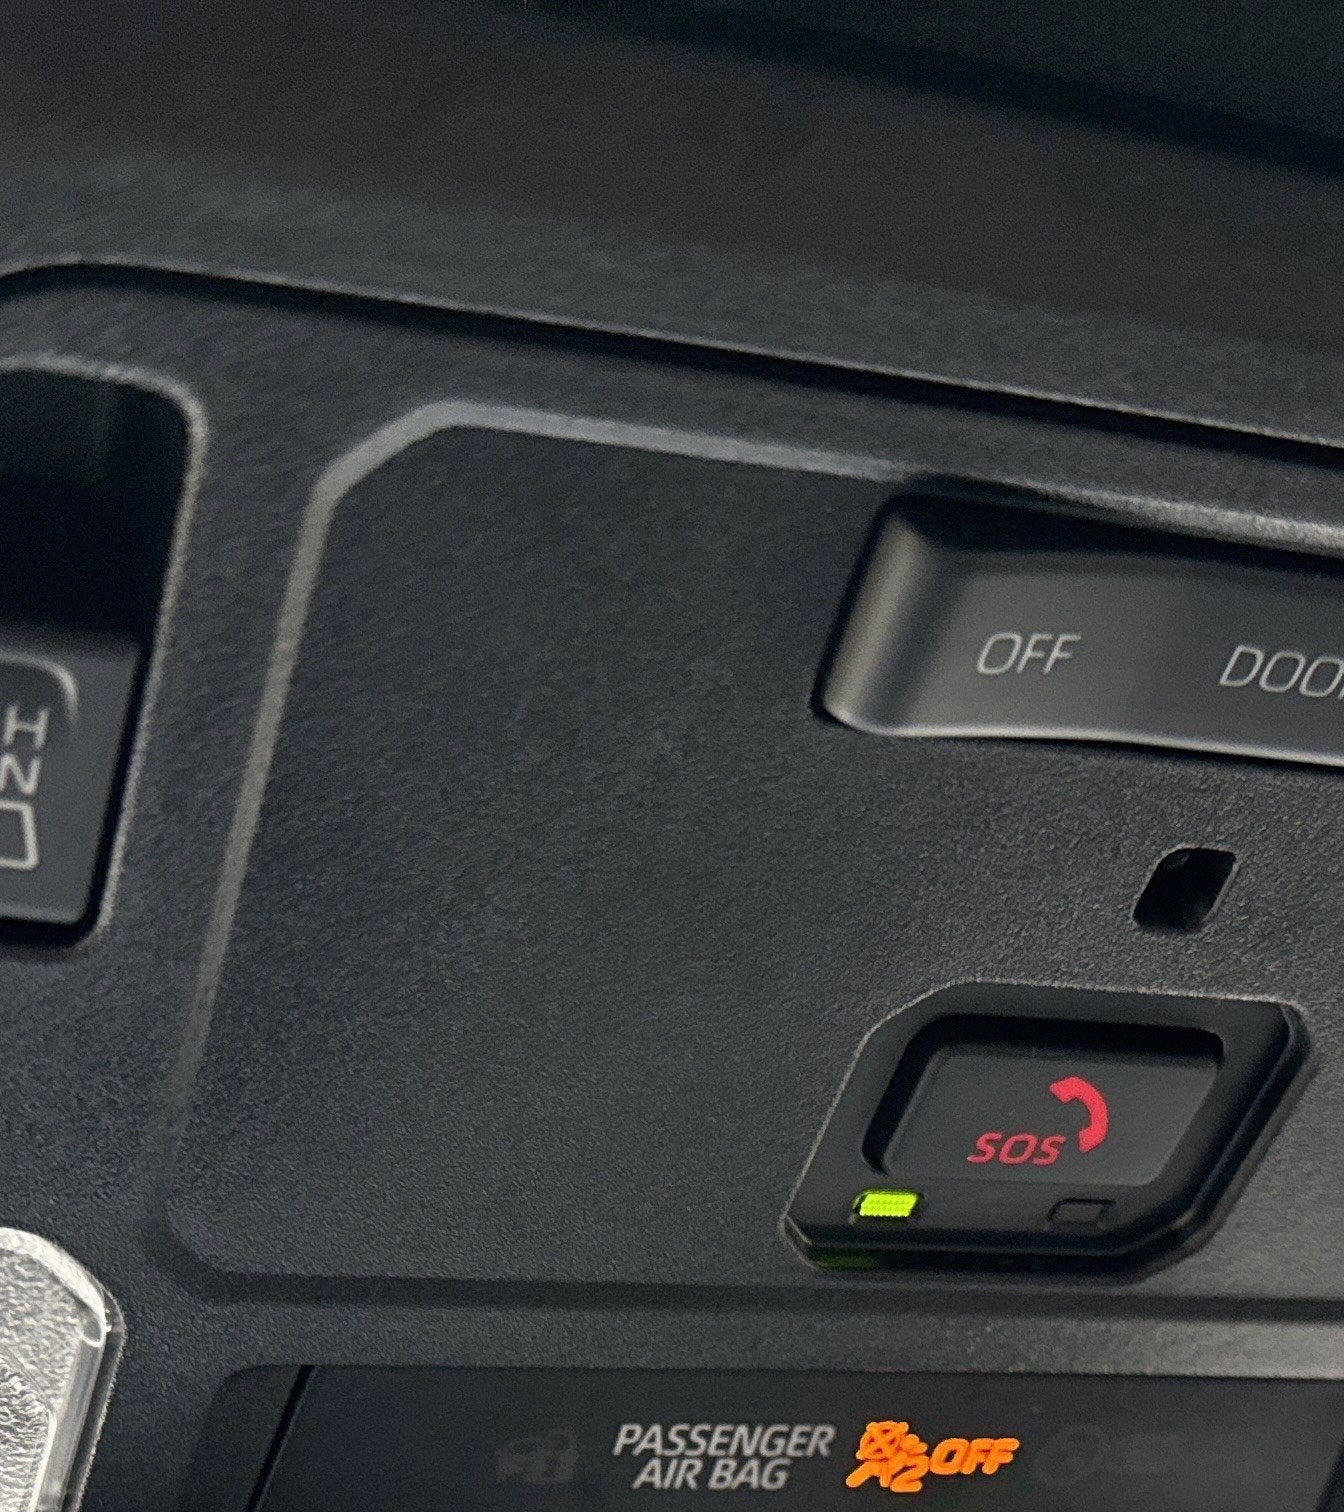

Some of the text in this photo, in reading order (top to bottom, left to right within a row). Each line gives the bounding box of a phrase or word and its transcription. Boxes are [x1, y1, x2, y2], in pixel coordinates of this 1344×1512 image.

[976, 631, 1081, 677] OFF
[967, 1132, 1067, 1167] SOS
[613, 1424, 836, 1459] PASSENGER
[929, 1437, 1021, 1476] OFF
[632, 1457, 790, 1491] AIR BAG
